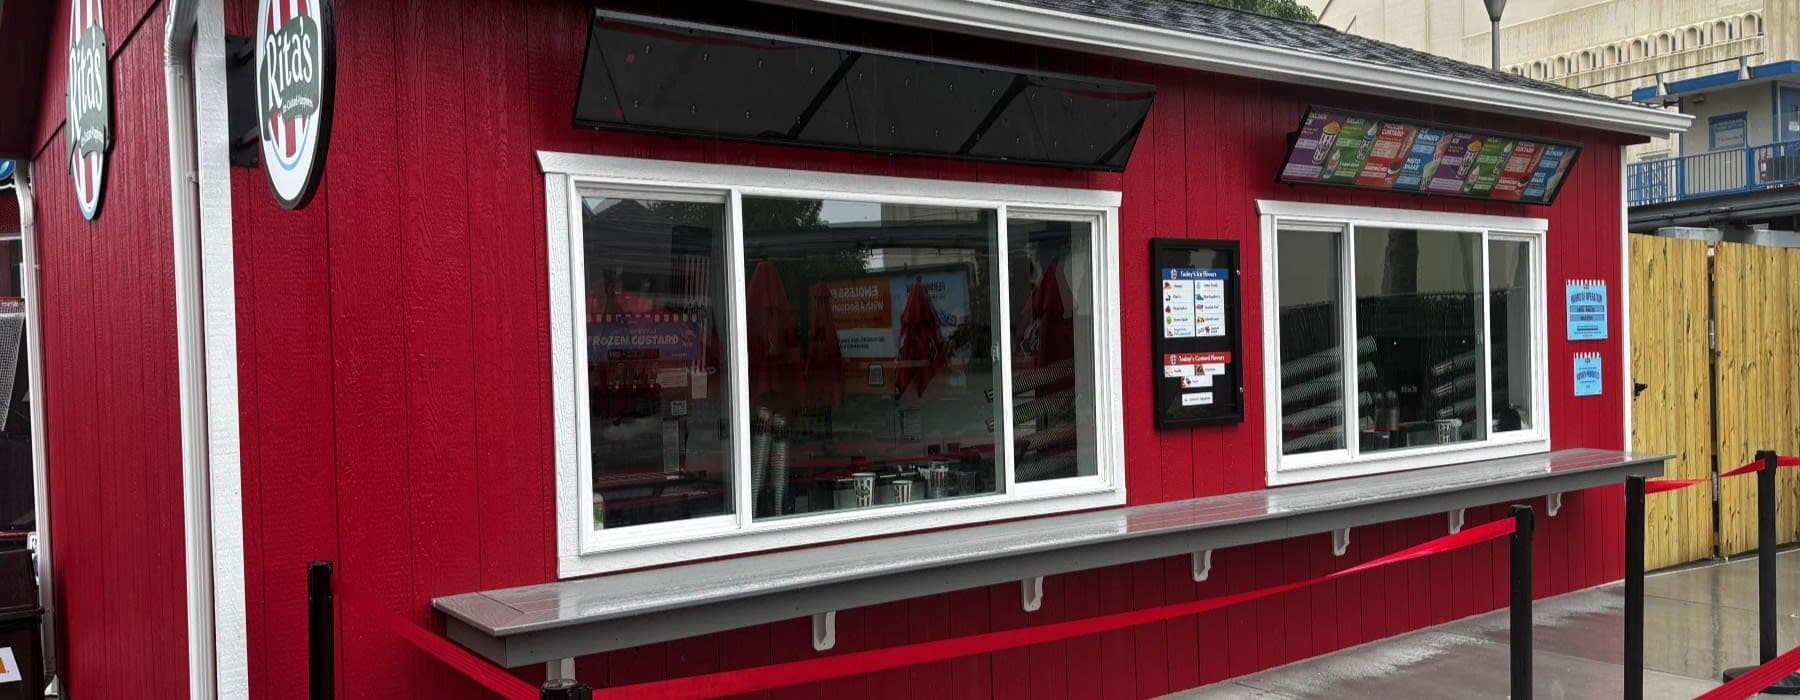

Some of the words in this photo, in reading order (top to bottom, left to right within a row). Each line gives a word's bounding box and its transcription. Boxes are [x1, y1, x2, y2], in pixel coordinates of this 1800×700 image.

[71, 26, 103, 143] Rita's
[266, 16, 313, 111] Rita's
[631, 334, 679, 346] CUSTARD
